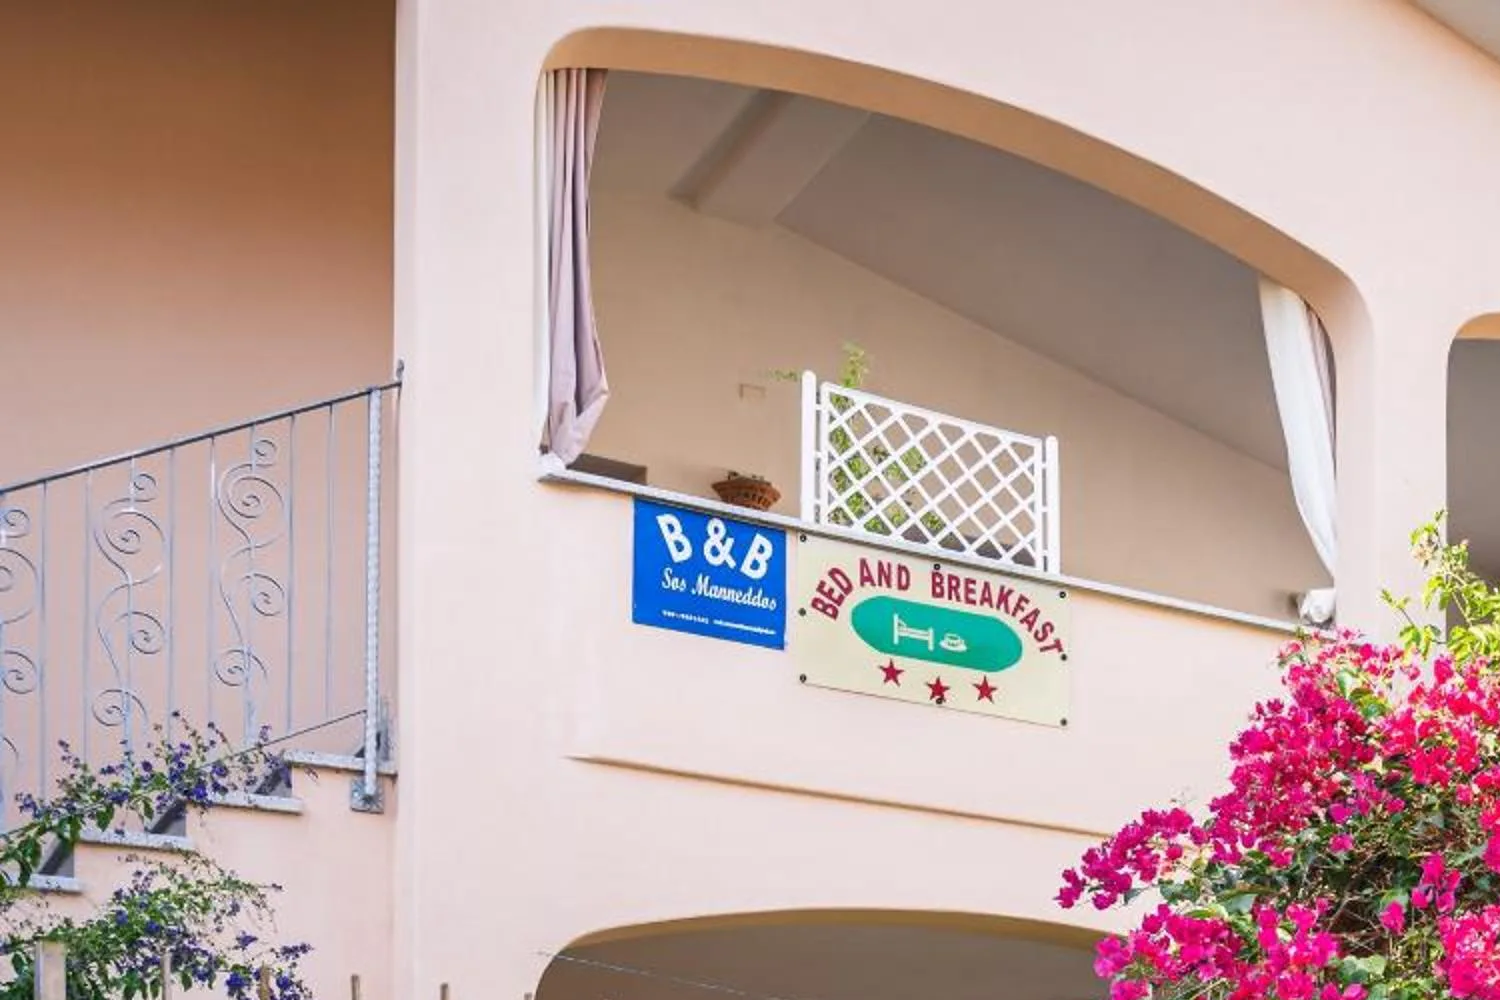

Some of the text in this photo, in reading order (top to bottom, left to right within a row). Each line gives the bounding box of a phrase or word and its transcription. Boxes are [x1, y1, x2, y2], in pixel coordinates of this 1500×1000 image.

[810, 557, 1065, 655] BED AND BREAKFAST
